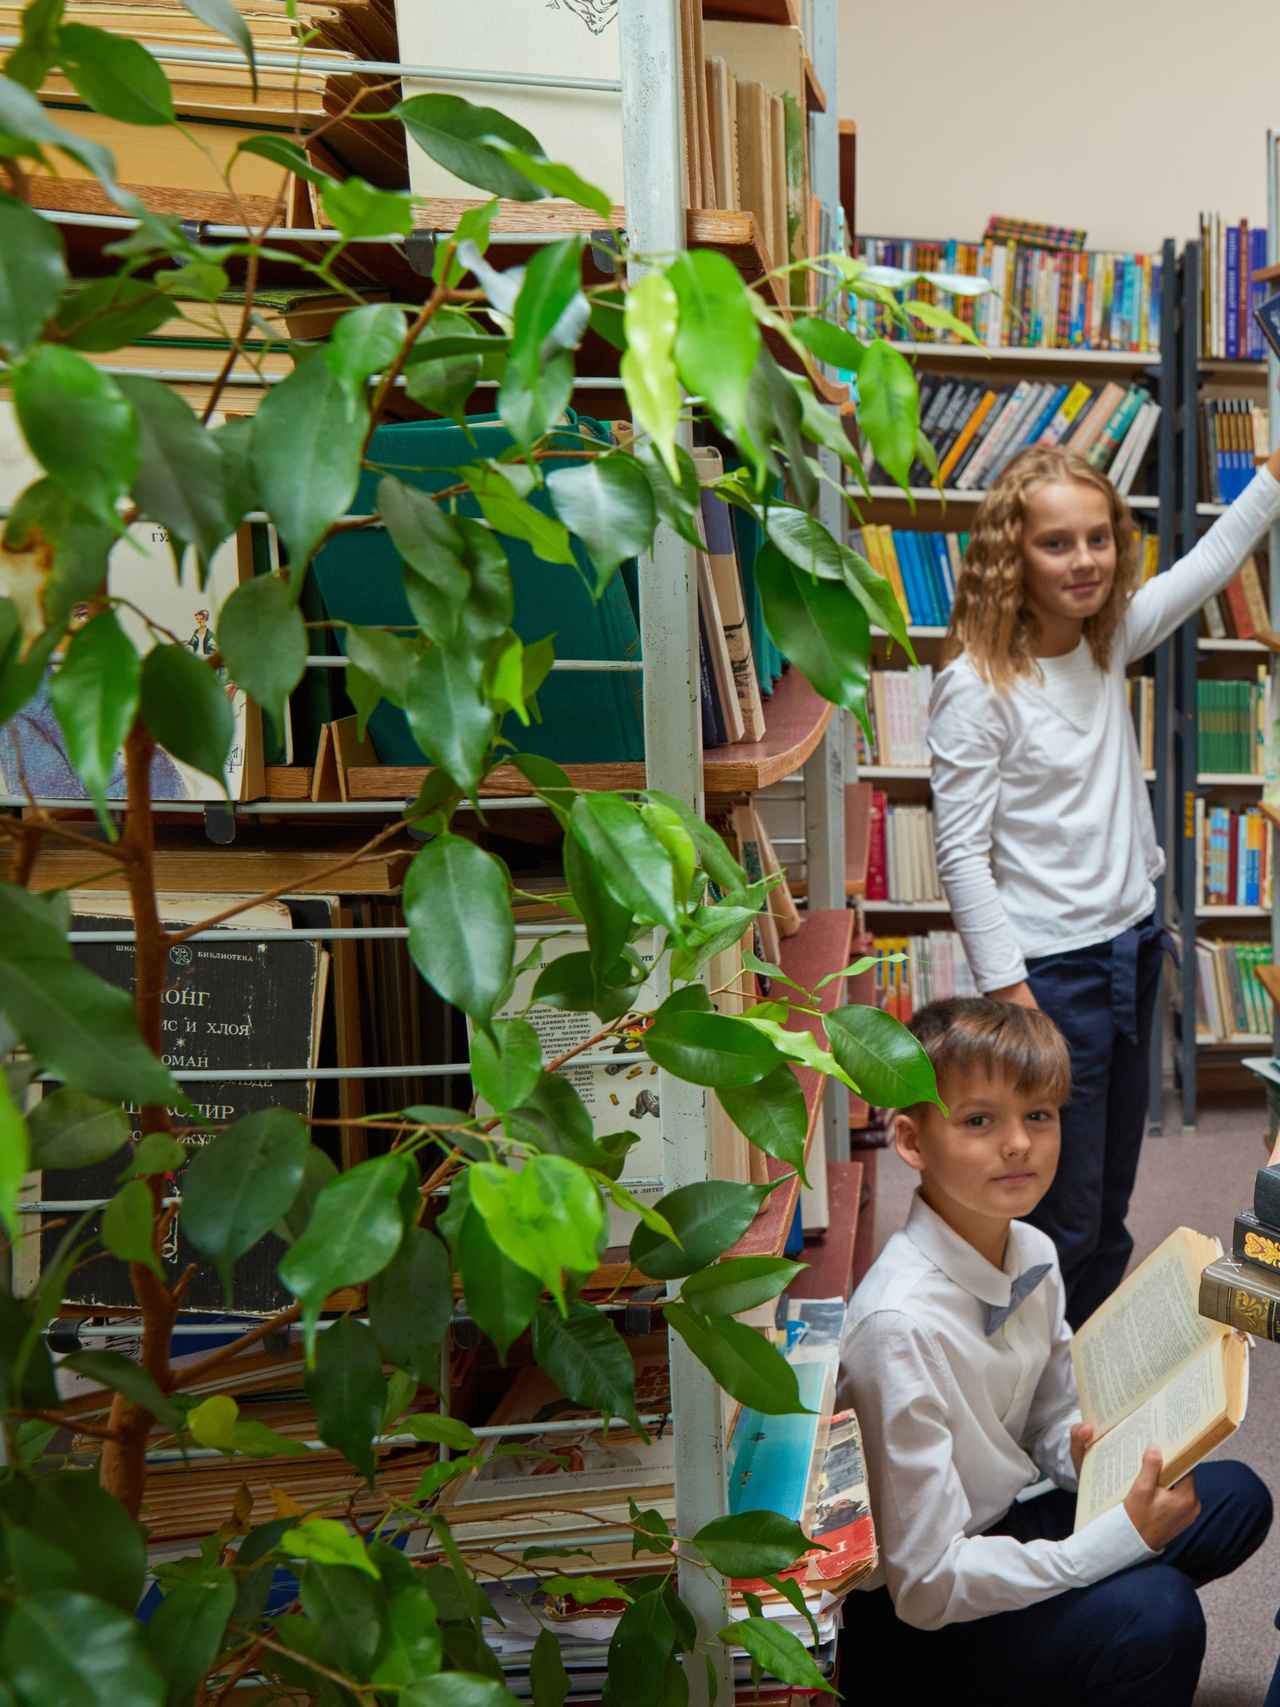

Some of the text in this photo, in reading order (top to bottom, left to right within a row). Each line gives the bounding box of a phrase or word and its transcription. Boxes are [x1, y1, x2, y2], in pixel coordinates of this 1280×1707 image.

[197, 951, 254, 963] БИБЛИОТЕКА
[161, 989, 211, 1007] ОНГ
[206, 1022, 250, 1036] ХЛОЯ
[160, 1054, 209, 1068] ОМАН
